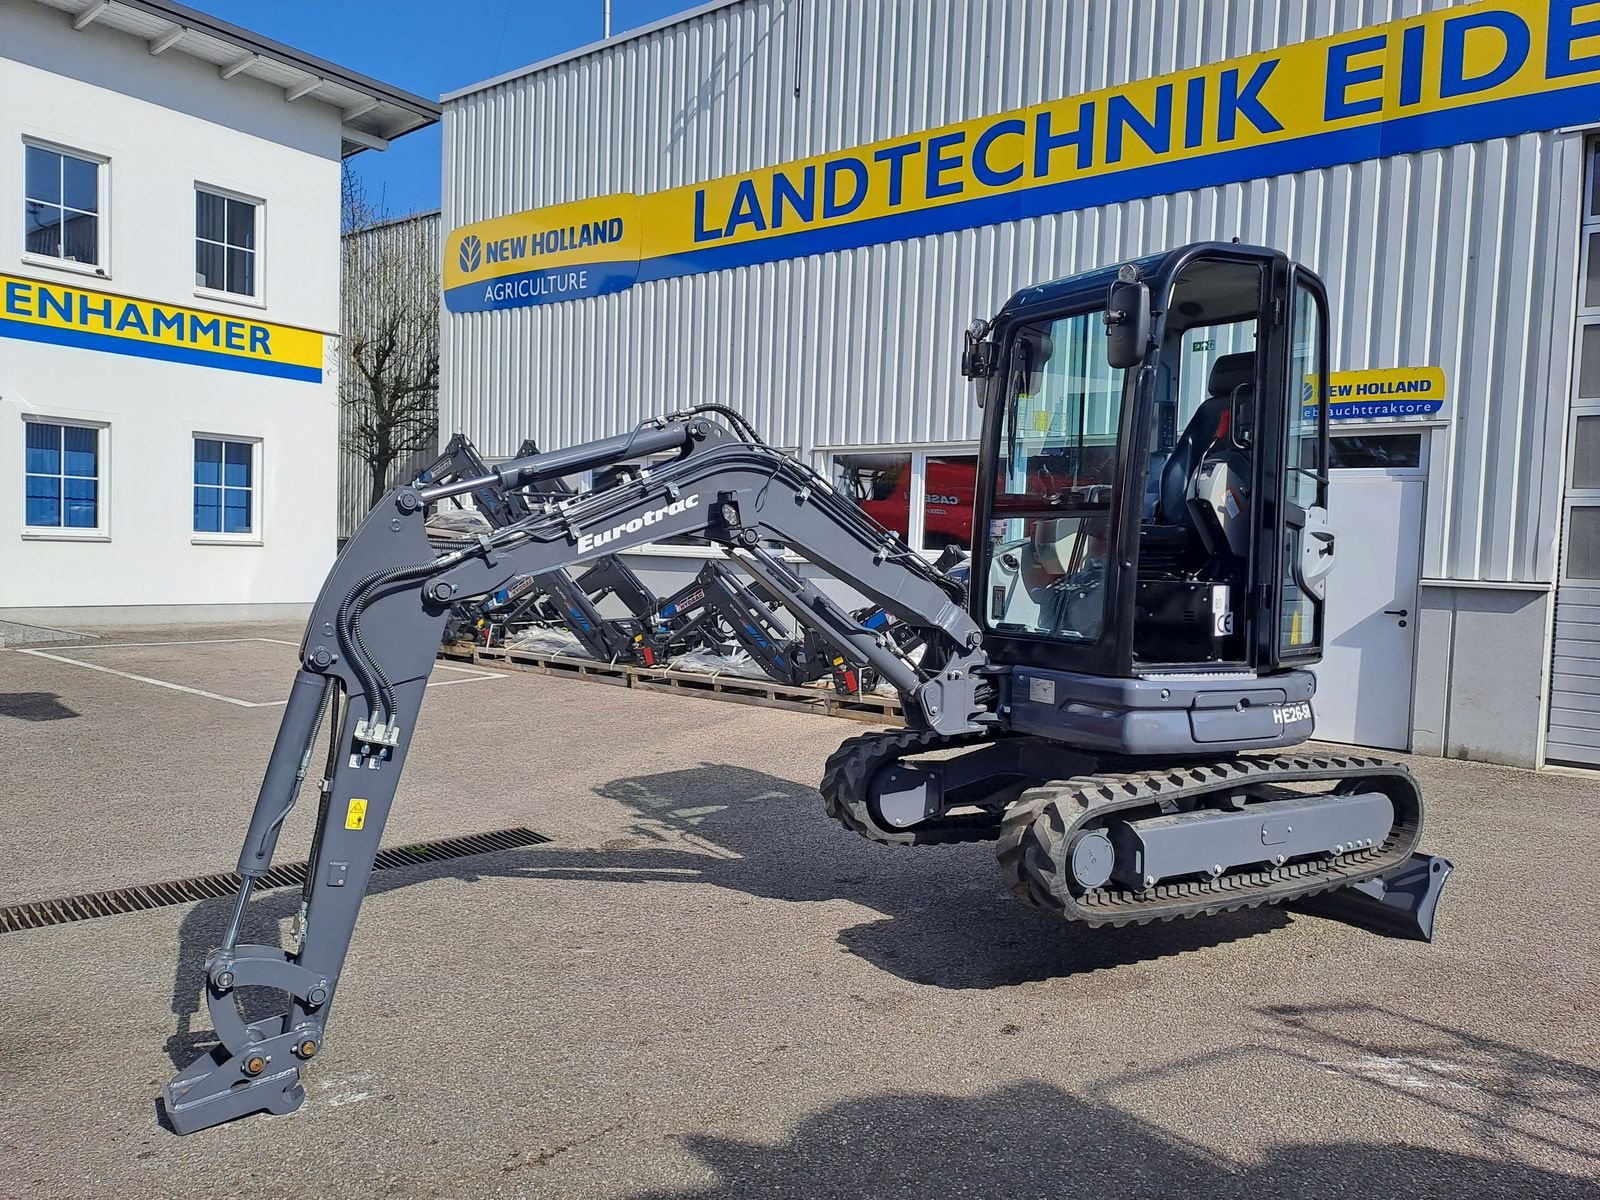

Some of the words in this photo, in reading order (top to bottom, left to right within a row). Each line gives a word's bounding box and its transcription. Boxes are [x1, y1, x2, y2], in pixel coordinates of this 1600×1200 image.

[693, 59, 1285, 243] LANDTECHNIK
[1323, 0, 1600, 121] EIDE
[486, 235, 528, 264] NEW
[531, 217, 624, 256] HOLLAND
[484, 270, 588, 302] AGRICULTURE
[6, 281, 272, 355] ENHAMMER
[1326, 384, 1353, 397] EW
[1356, 379, 1432, 396] HOLLAND
[577, 493, 699, 555] Eurotrac
